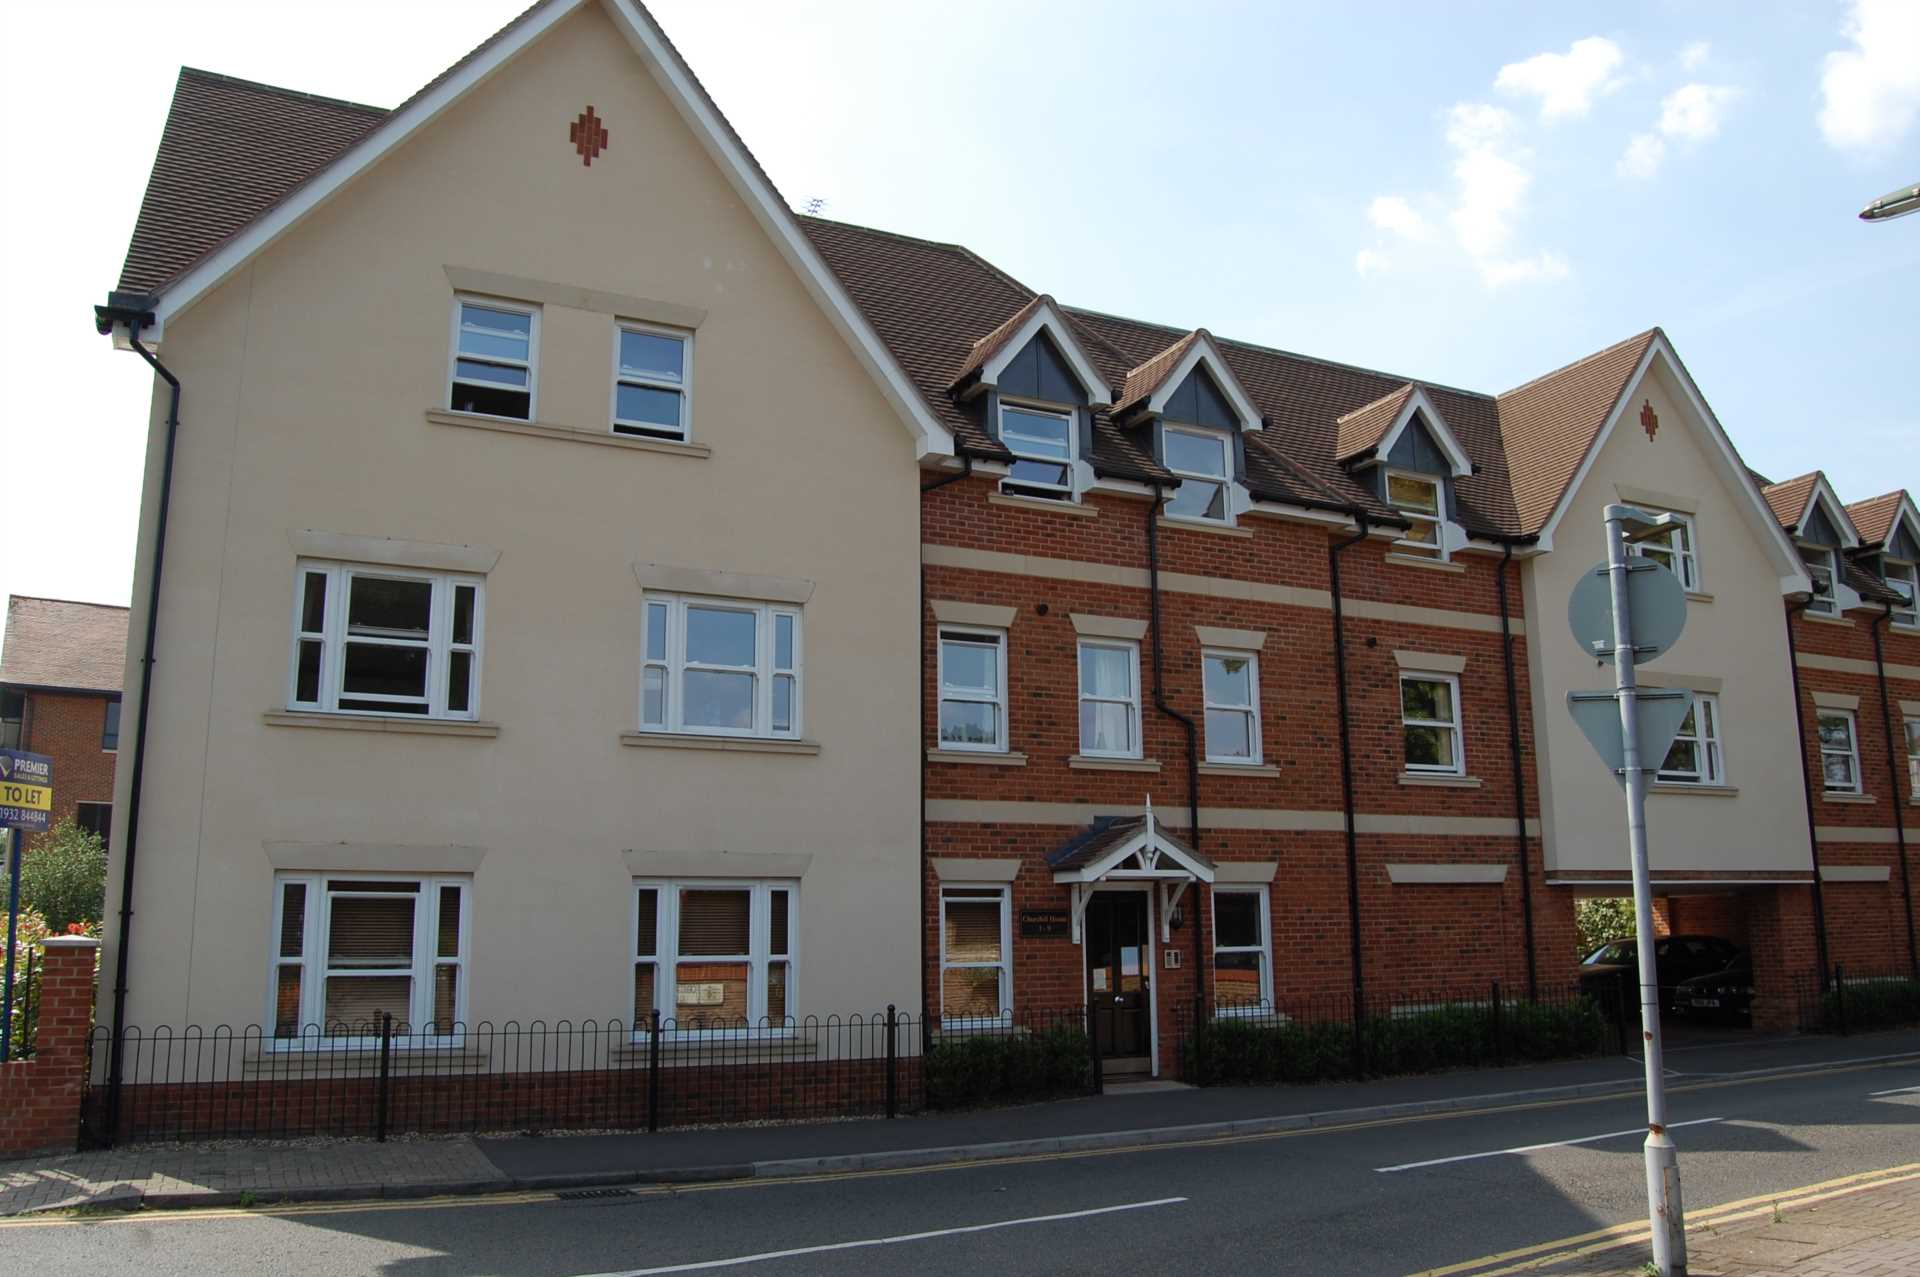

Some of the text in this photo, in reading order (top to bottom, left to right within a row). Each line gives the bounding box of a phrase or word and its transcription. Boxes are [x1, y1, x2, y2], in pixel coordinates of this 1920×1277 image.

[14, 759, 49, 775] PREMIER
[4, 786, 42, 805] TO LET
